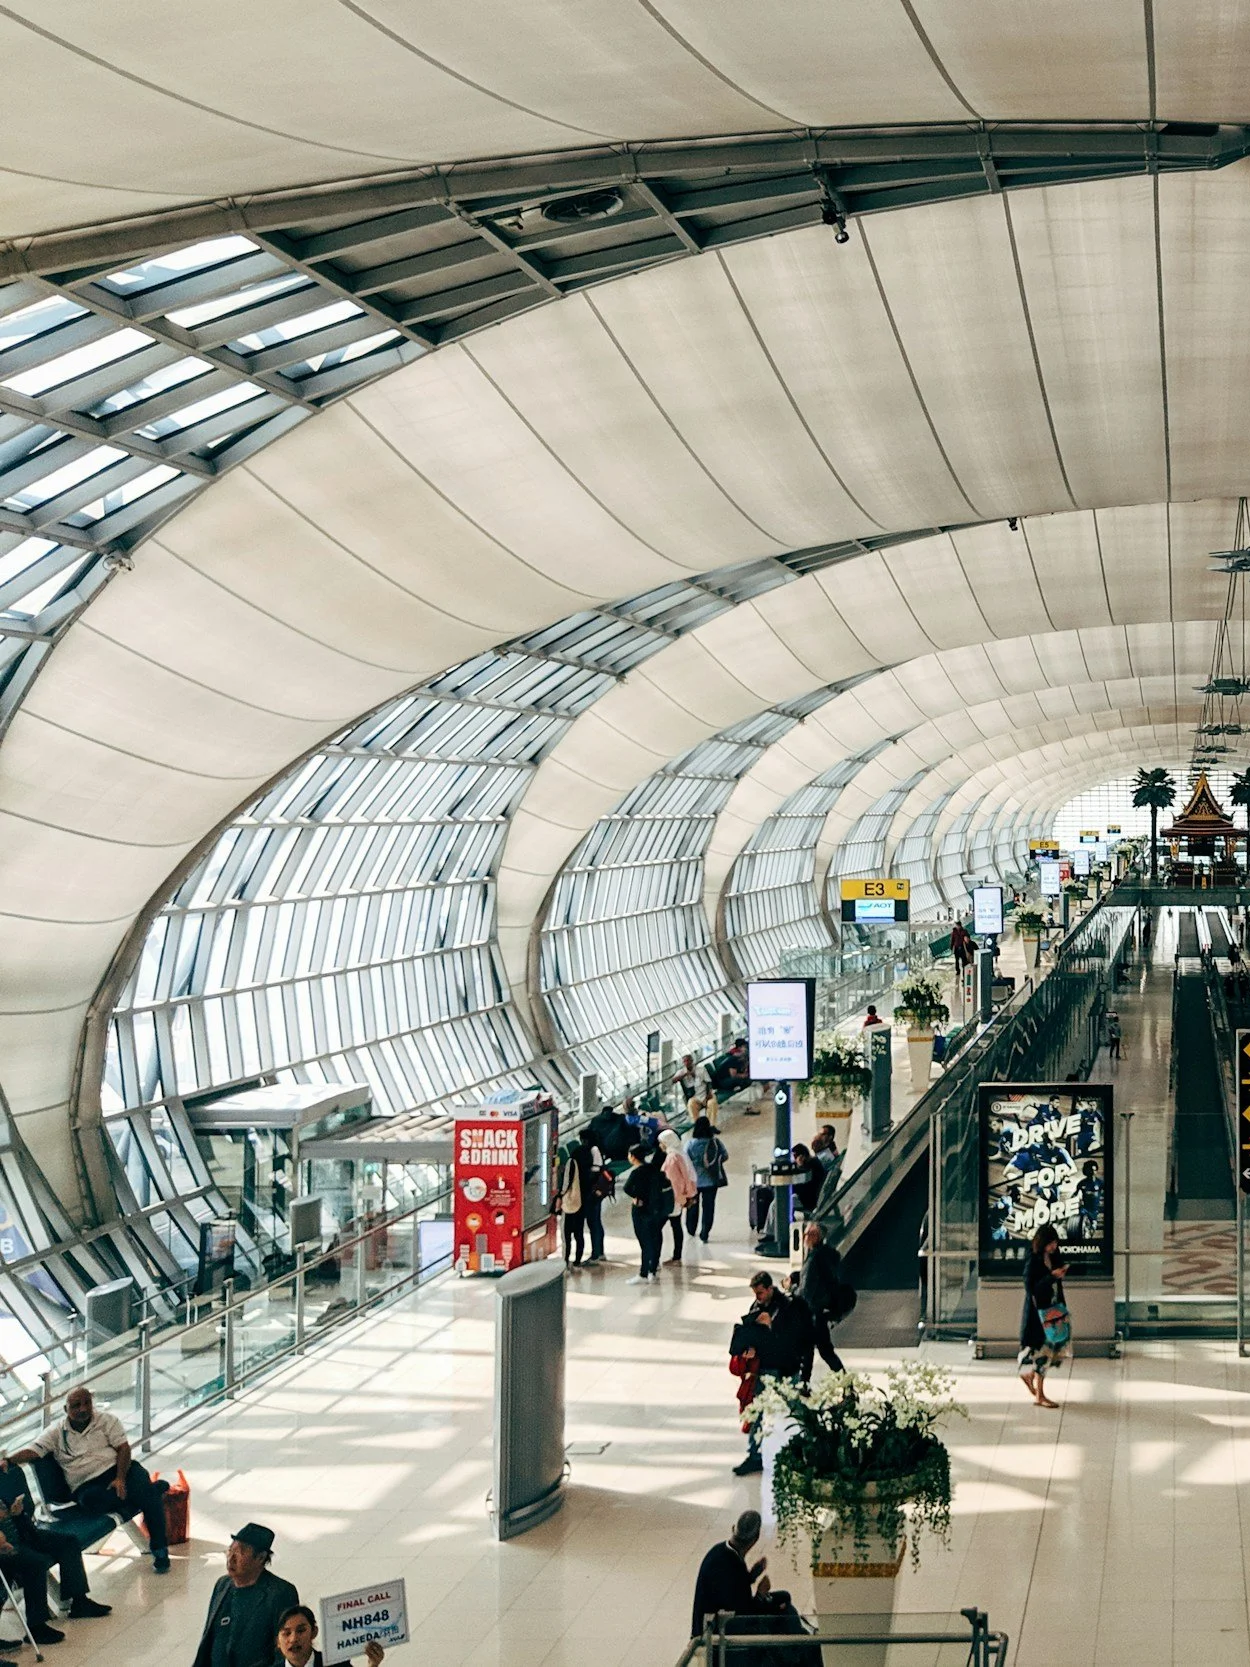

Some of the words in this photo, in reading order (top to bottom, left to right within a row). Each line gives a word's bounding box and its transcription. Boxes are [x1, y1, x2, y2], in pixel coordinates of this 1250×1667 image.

[1039, 841, 1050, 849] E5
[864, 882, 885, 896] E3
[460, 1128, 519, 1149] SNACK
[459, 1148, 519, 1166] &DRINK
[1014, 1196, 1080, 1231] MORE
[1058, 1245, 1101, 1254] YOKOHAMA
[337, 1599, 365, 1611] FINAL
[367, 1591, 391, 1603] CALL
[342, 1609, 389, 1631] NH848
